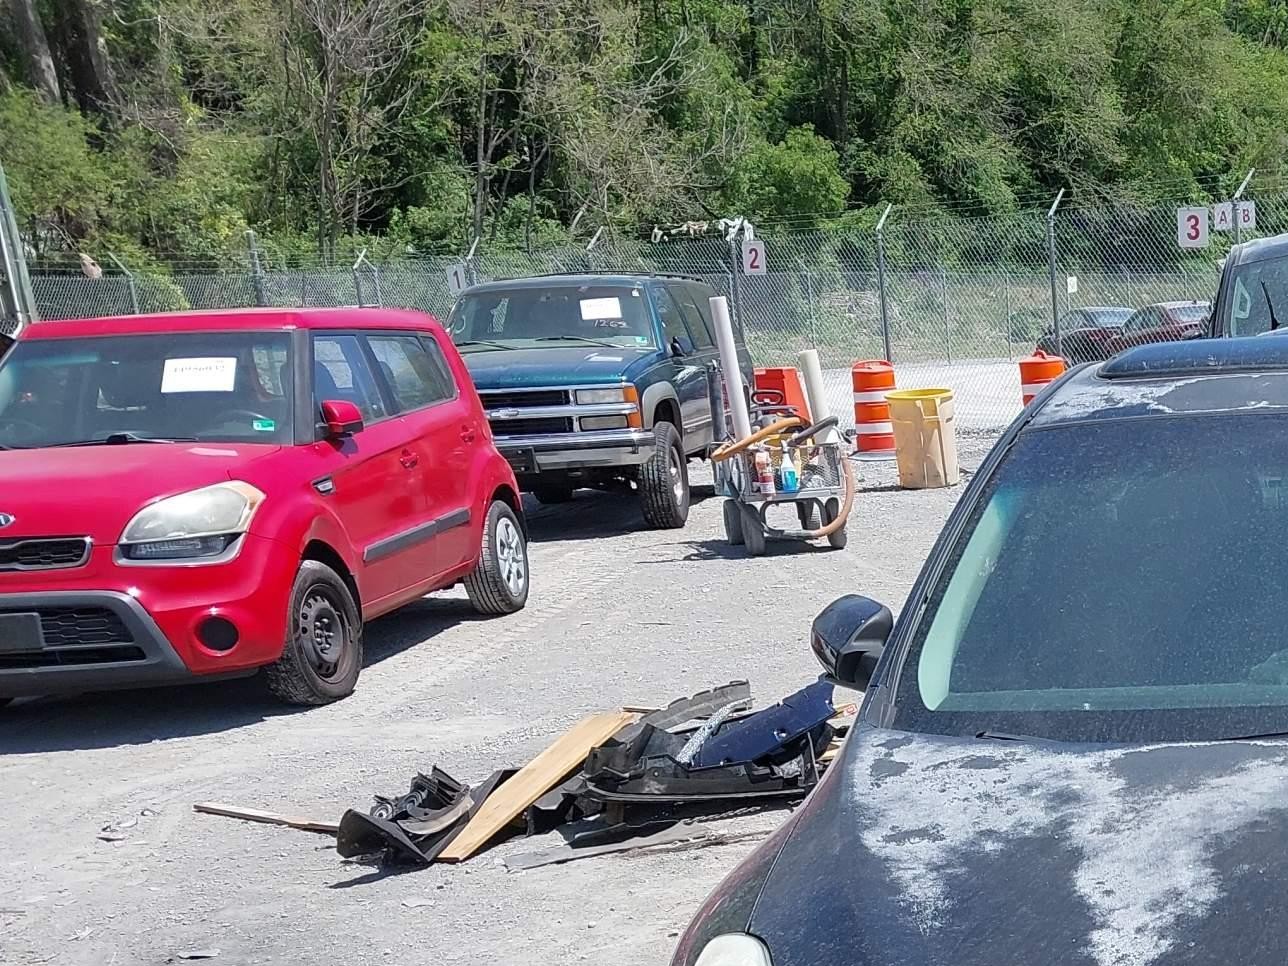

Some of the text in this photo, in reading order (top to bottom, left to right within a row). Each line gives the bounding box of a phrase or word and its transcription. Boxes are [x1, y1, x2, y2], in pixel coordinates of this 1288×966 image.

[1219, 209, 1228, 225] A
[1242, 208, 1250, 223] B
[1186, 214, 1200, 240] 3
[748, 247, 760, 269] 2
[453, 270, 461, 289] 1
